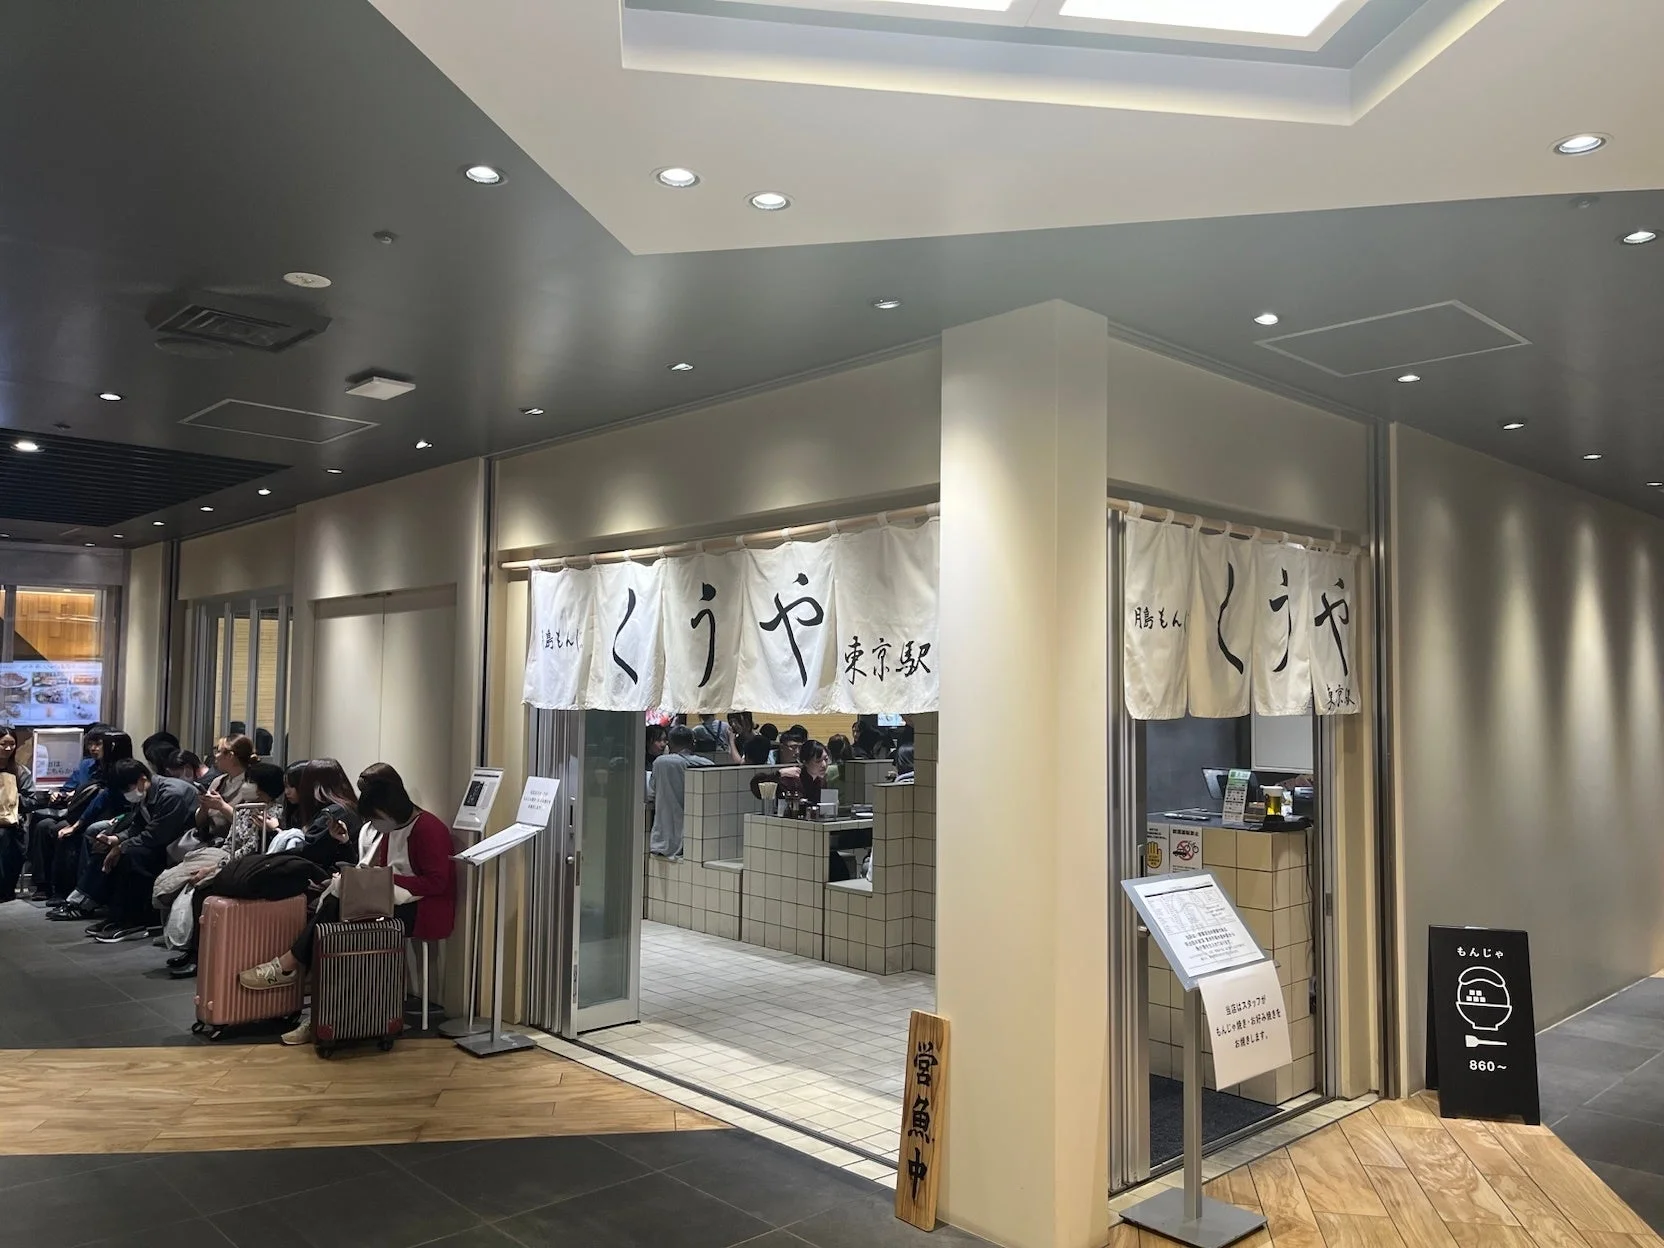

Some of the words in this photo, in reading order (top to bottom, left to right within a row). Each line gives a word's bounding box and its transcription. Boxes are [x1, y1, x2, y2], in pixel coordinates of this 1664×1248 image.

[844, 636, 931, 685] 東京駅
[1456, 946, 1505, 959] もんじゃ
